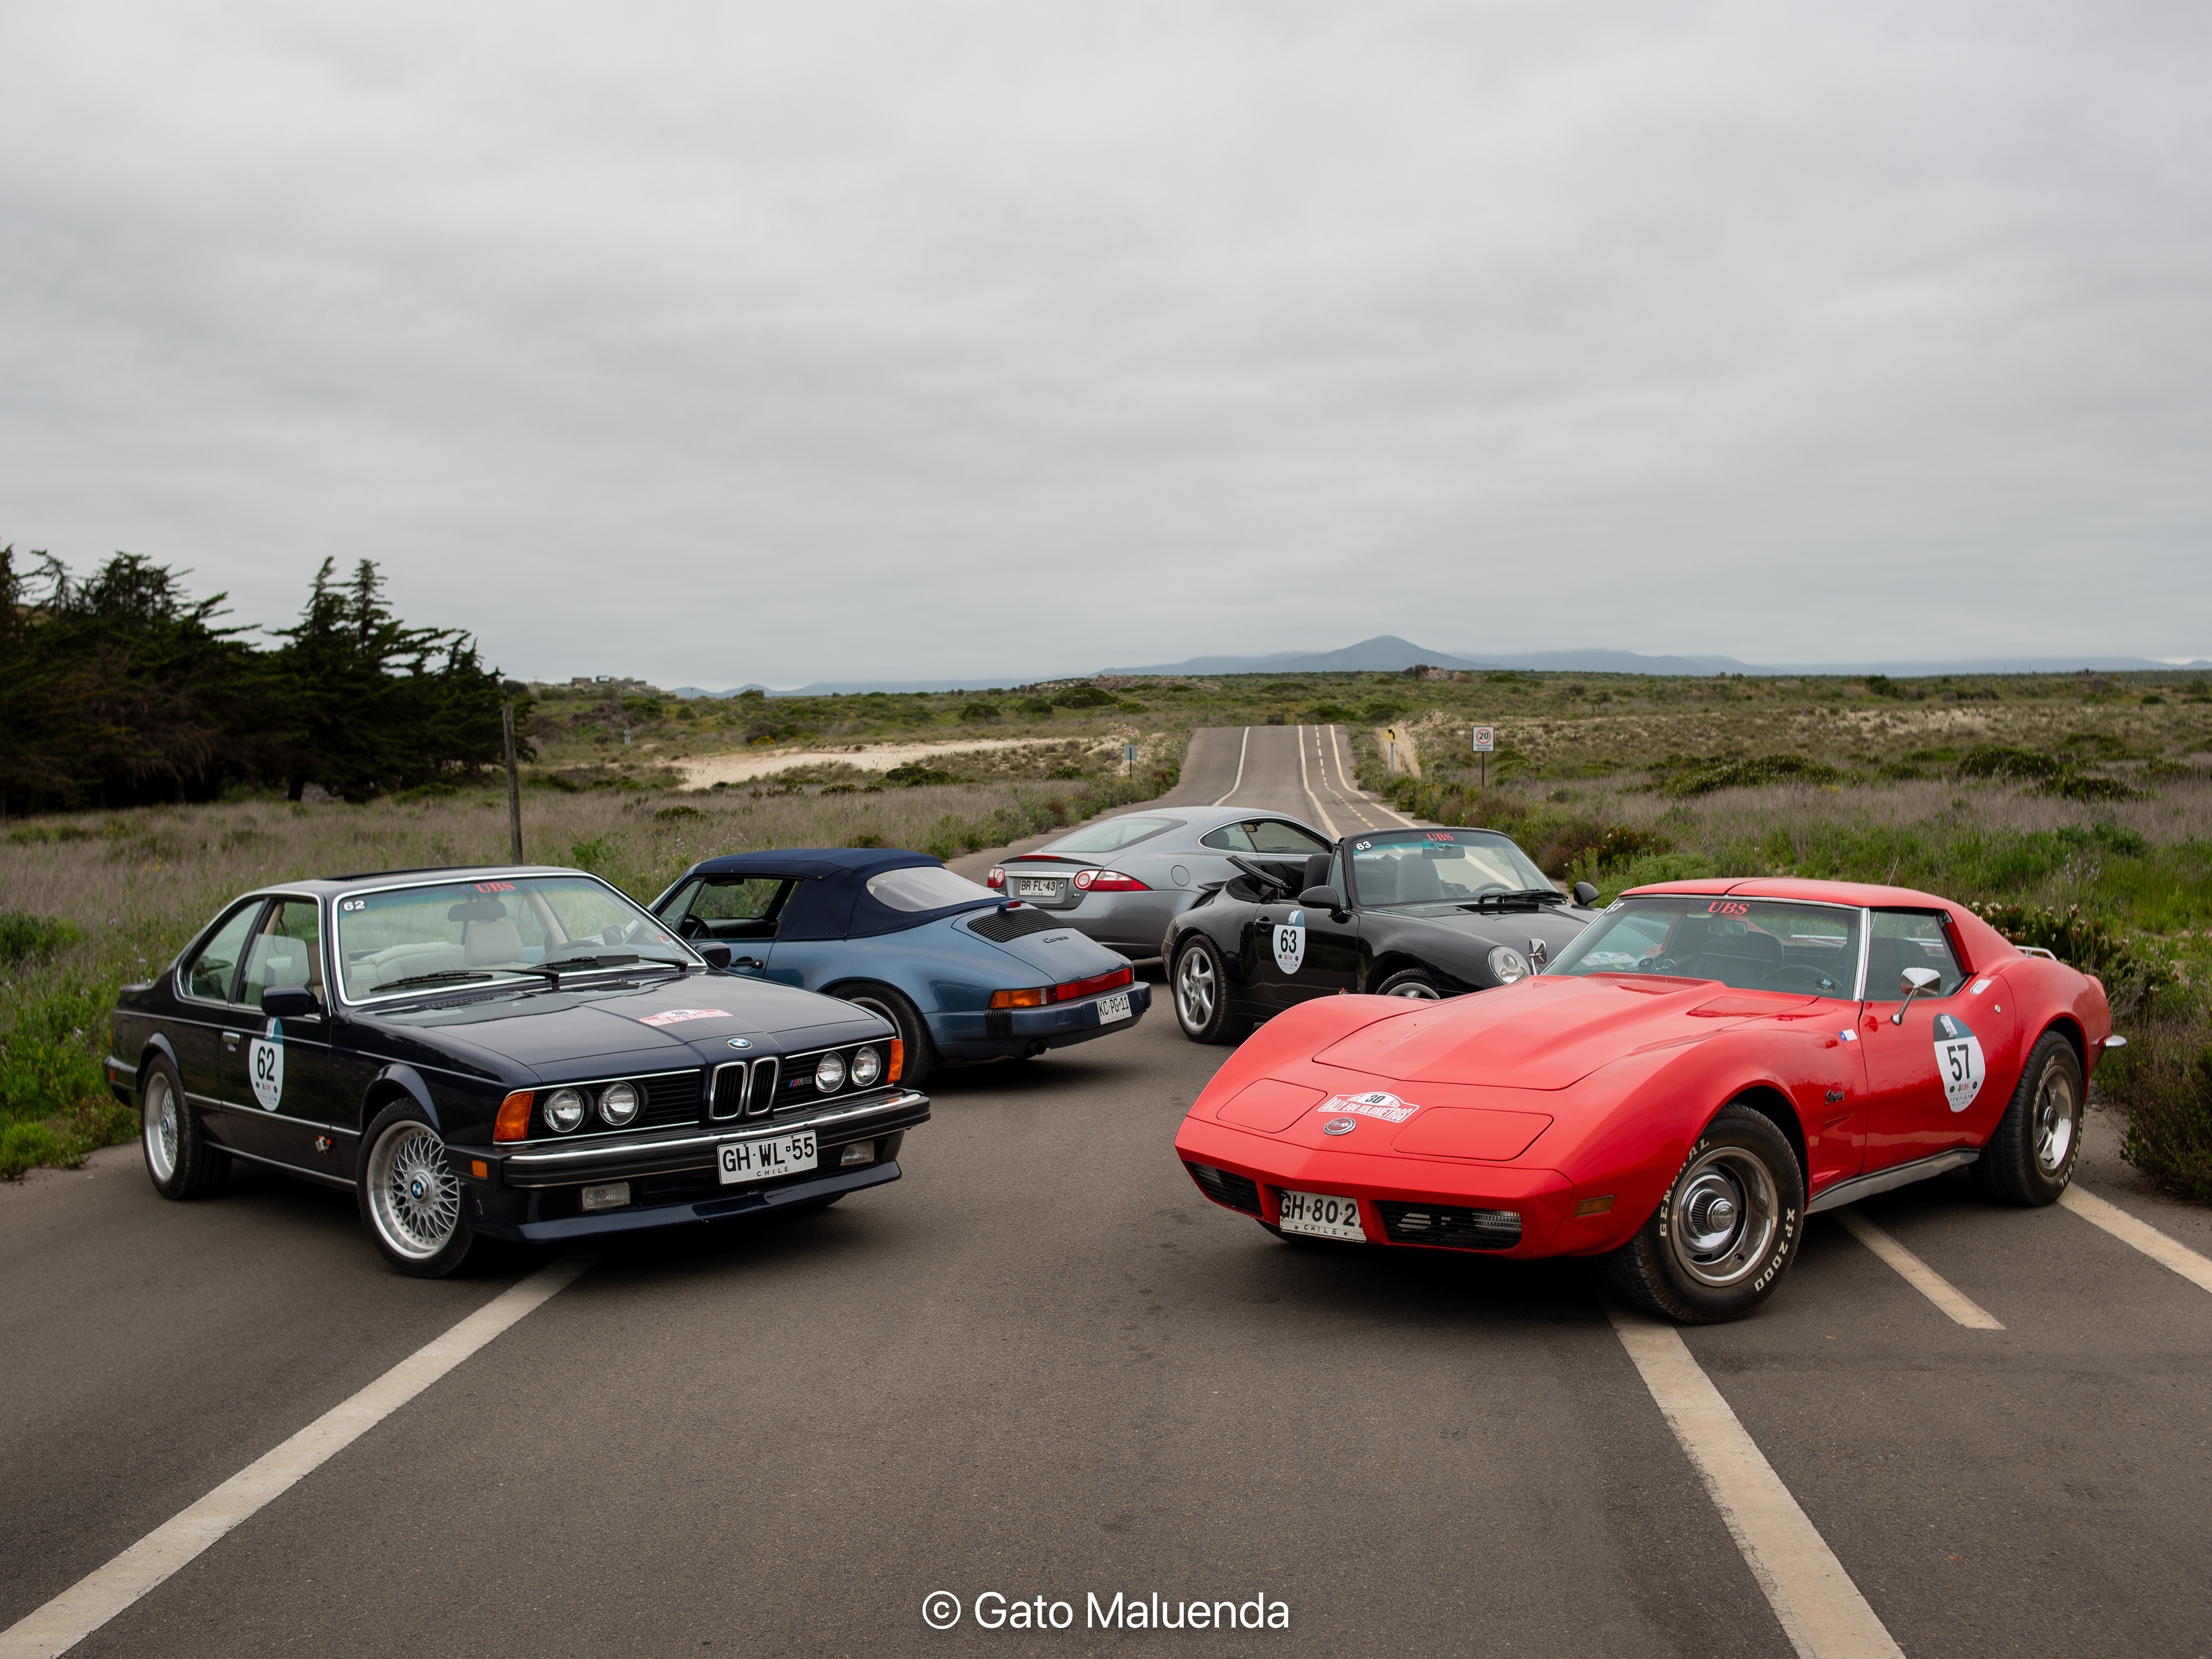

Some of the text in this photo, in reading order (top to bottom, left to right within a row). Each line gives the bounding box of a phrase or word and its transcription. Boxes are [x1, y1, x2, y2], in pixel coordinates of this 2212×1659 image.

[1425, 833, 1453, 842] UBS
[1355, 841, 1372, 851] 63
[474, 882, 516, 893] UBS
[343, 900, 365, 911] 62
[1708, 902, 1750, 915] UBS
[1281, 929, 1297, 953] 63
[257, 1046, 275, 1082] 62
[1946, 1044, 1970, 1082] 57
[1365, 1094, 1386, 1104] 30
[1321, 1097, 1414, 1121] RALLY 500 KILOMETROS
[2059, 1118, 2084, 1187] GENERAL
[756, 1166, 789, 1176] CHILE
[1660, 1139, 1710, 1237] GENAL
[1304, 1224, 1338, 1234] CHILE
[1754, 1208, 1796, 1292] XP 2000
